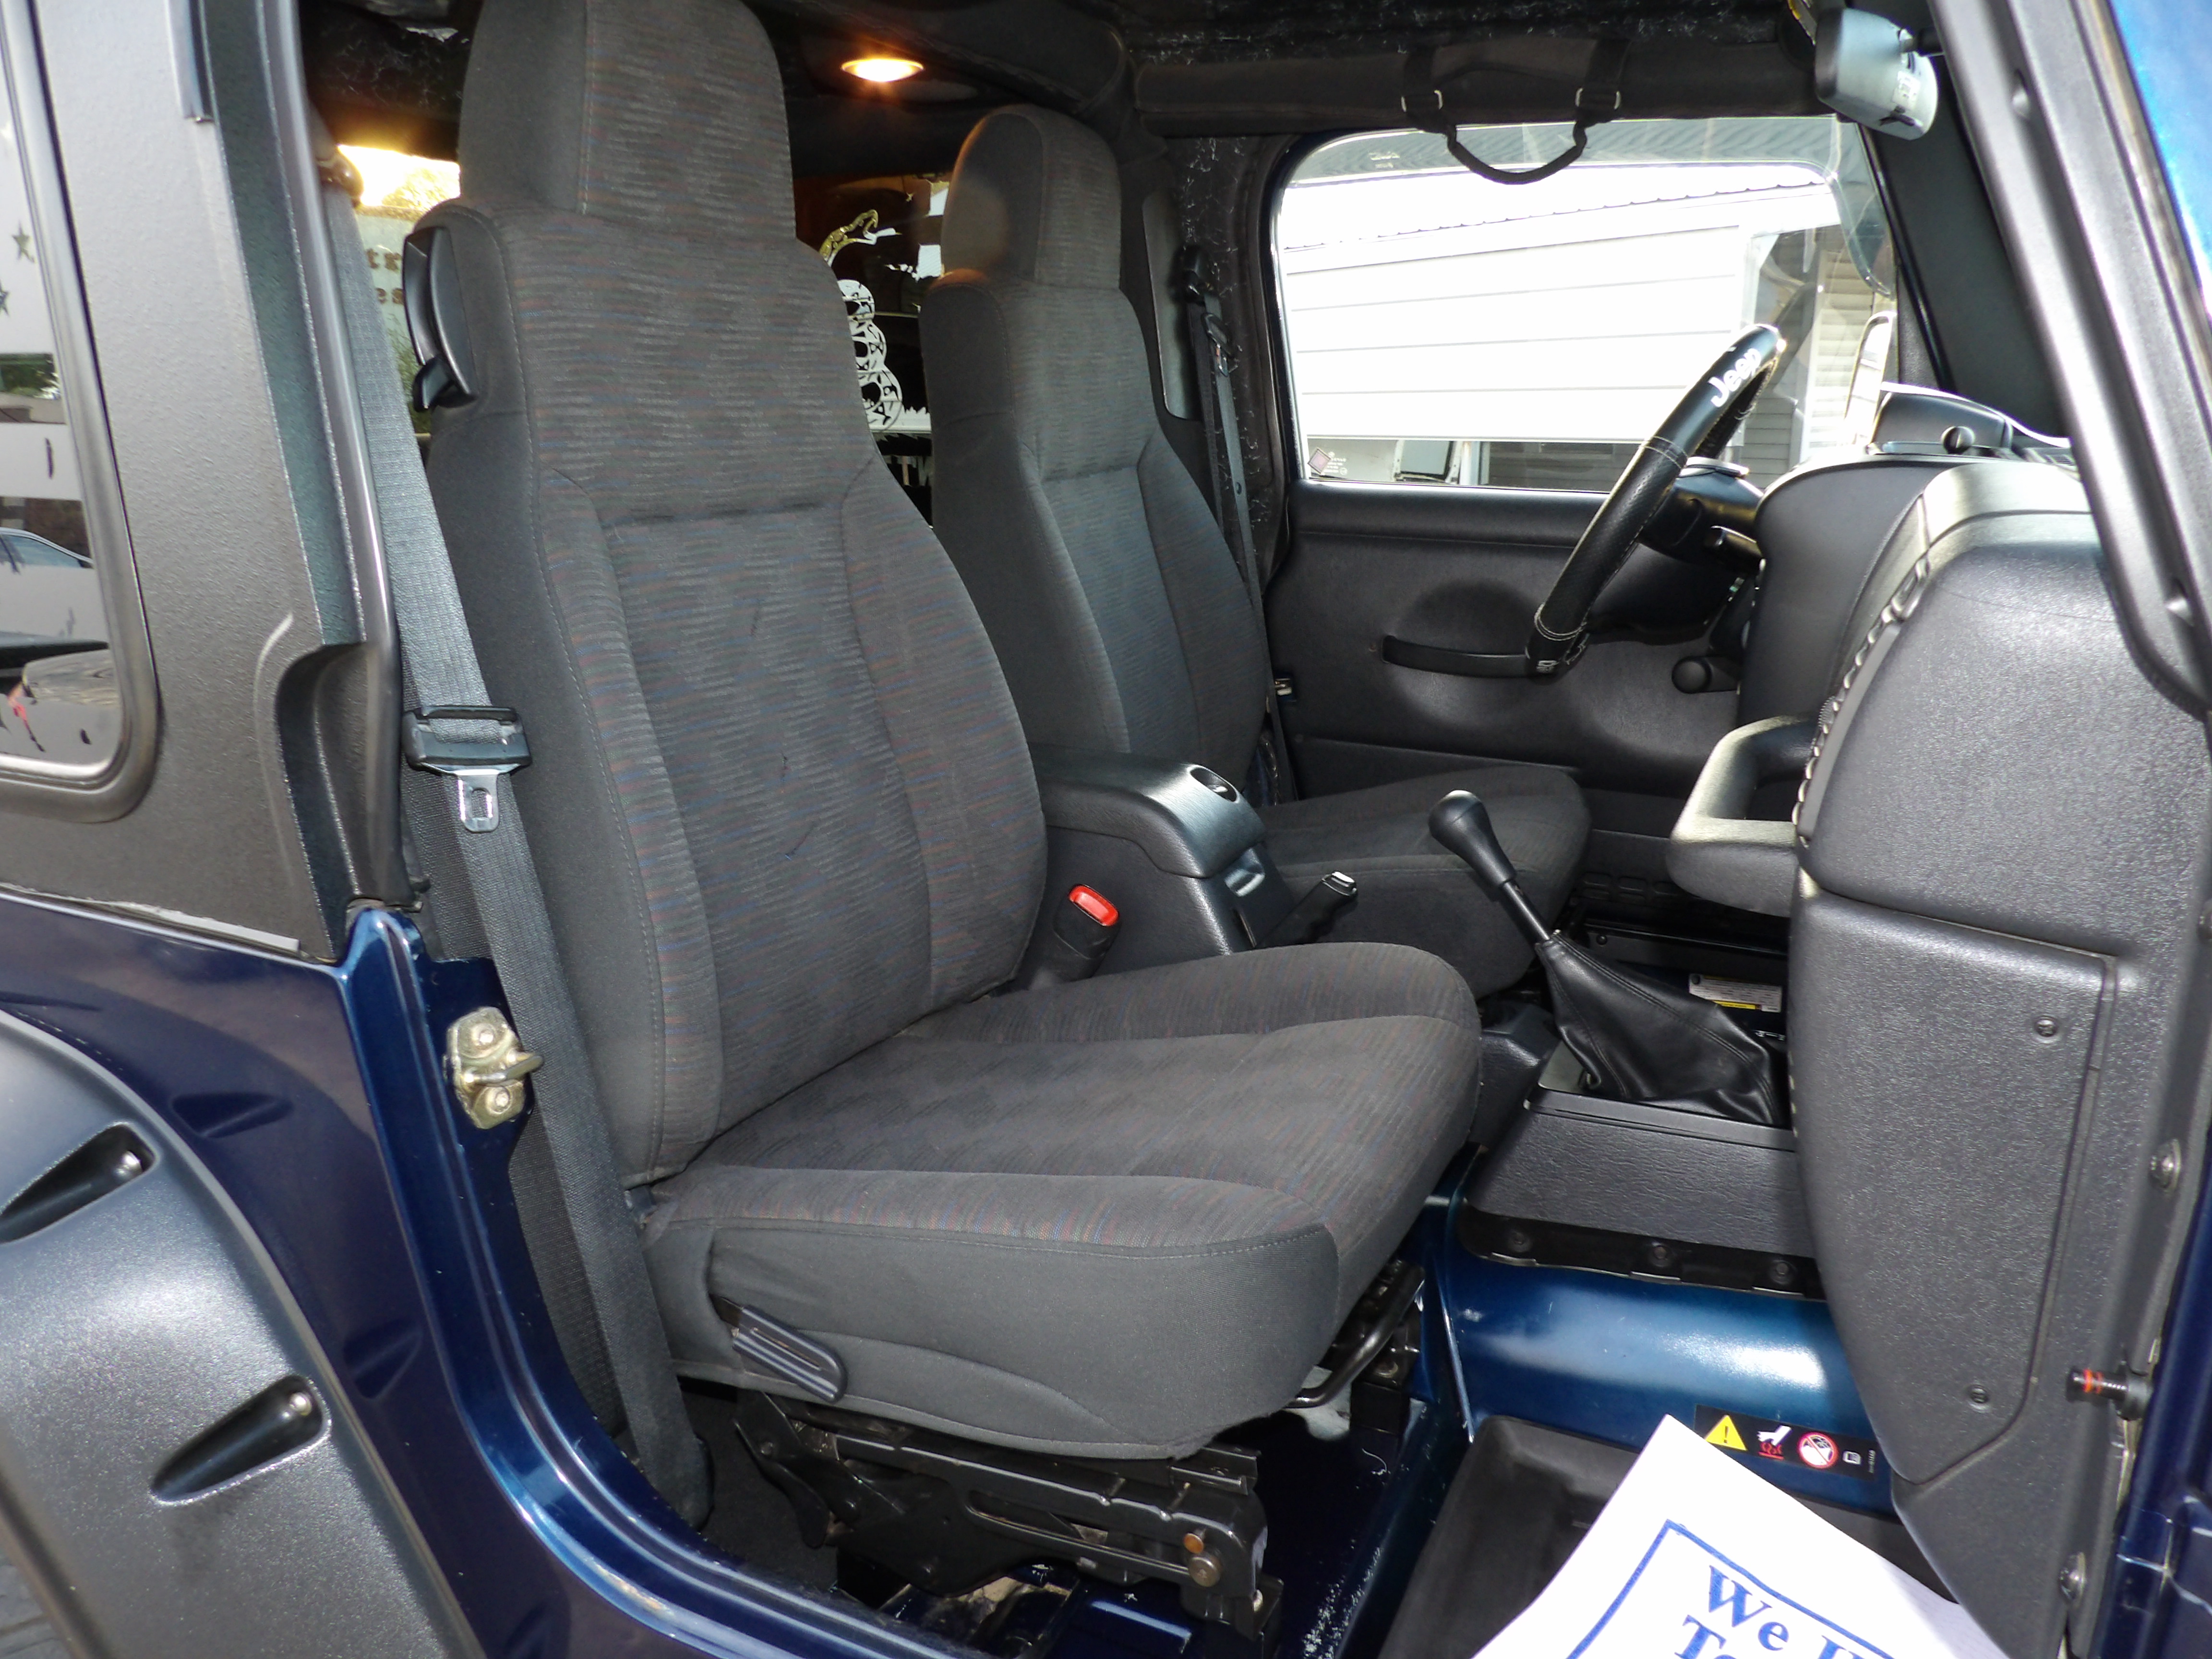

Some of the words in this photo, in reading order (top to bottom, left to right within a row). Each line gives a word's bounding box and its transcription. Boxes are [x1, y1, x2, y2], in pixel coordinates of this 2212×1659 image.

[1707, 348, 1762, 408] Jeep
[1674, 1614, 1739, 1659] T
[1709, 1565, 1789, 1651] We
